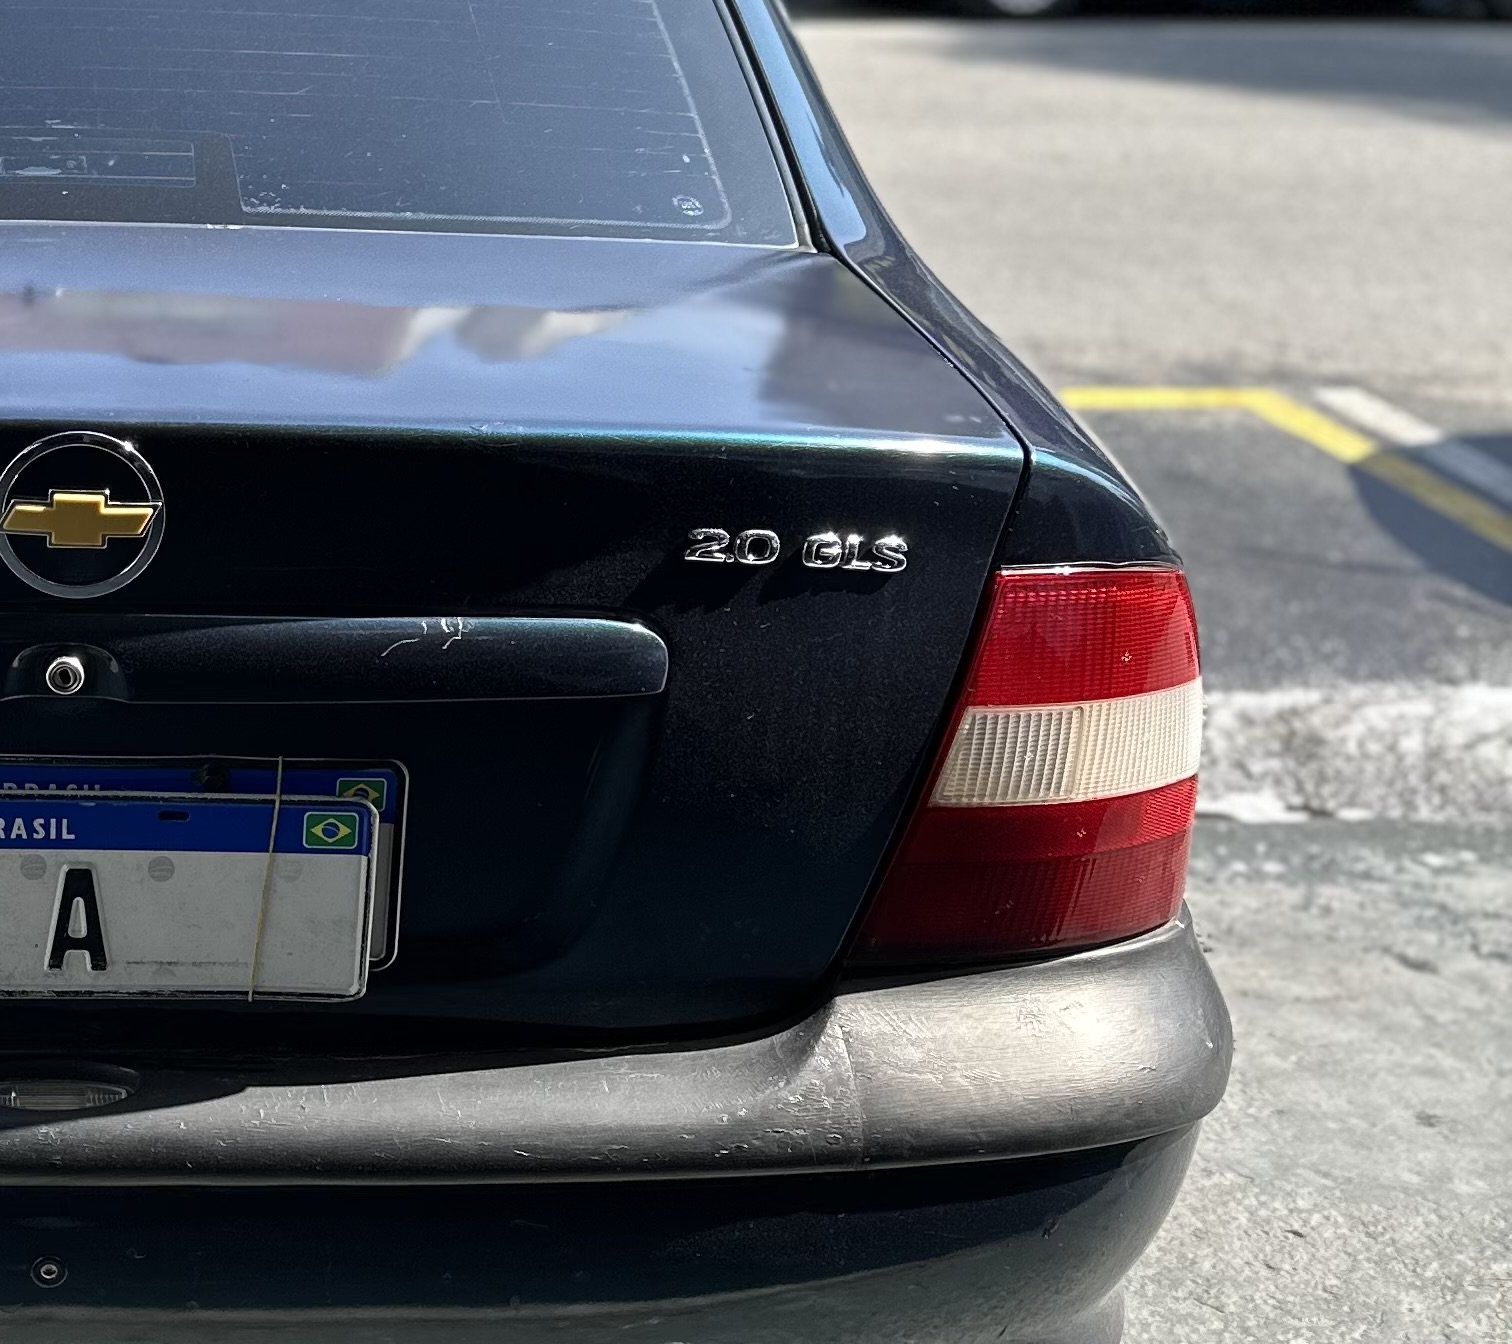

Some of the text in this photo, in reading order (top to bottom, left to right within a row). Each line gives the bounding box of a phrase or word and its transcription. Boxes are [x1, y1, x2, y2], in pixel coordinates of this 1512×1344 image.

[684, 527, 909, 573] 2.0 GLS
[43, 865, 110, 972] A
